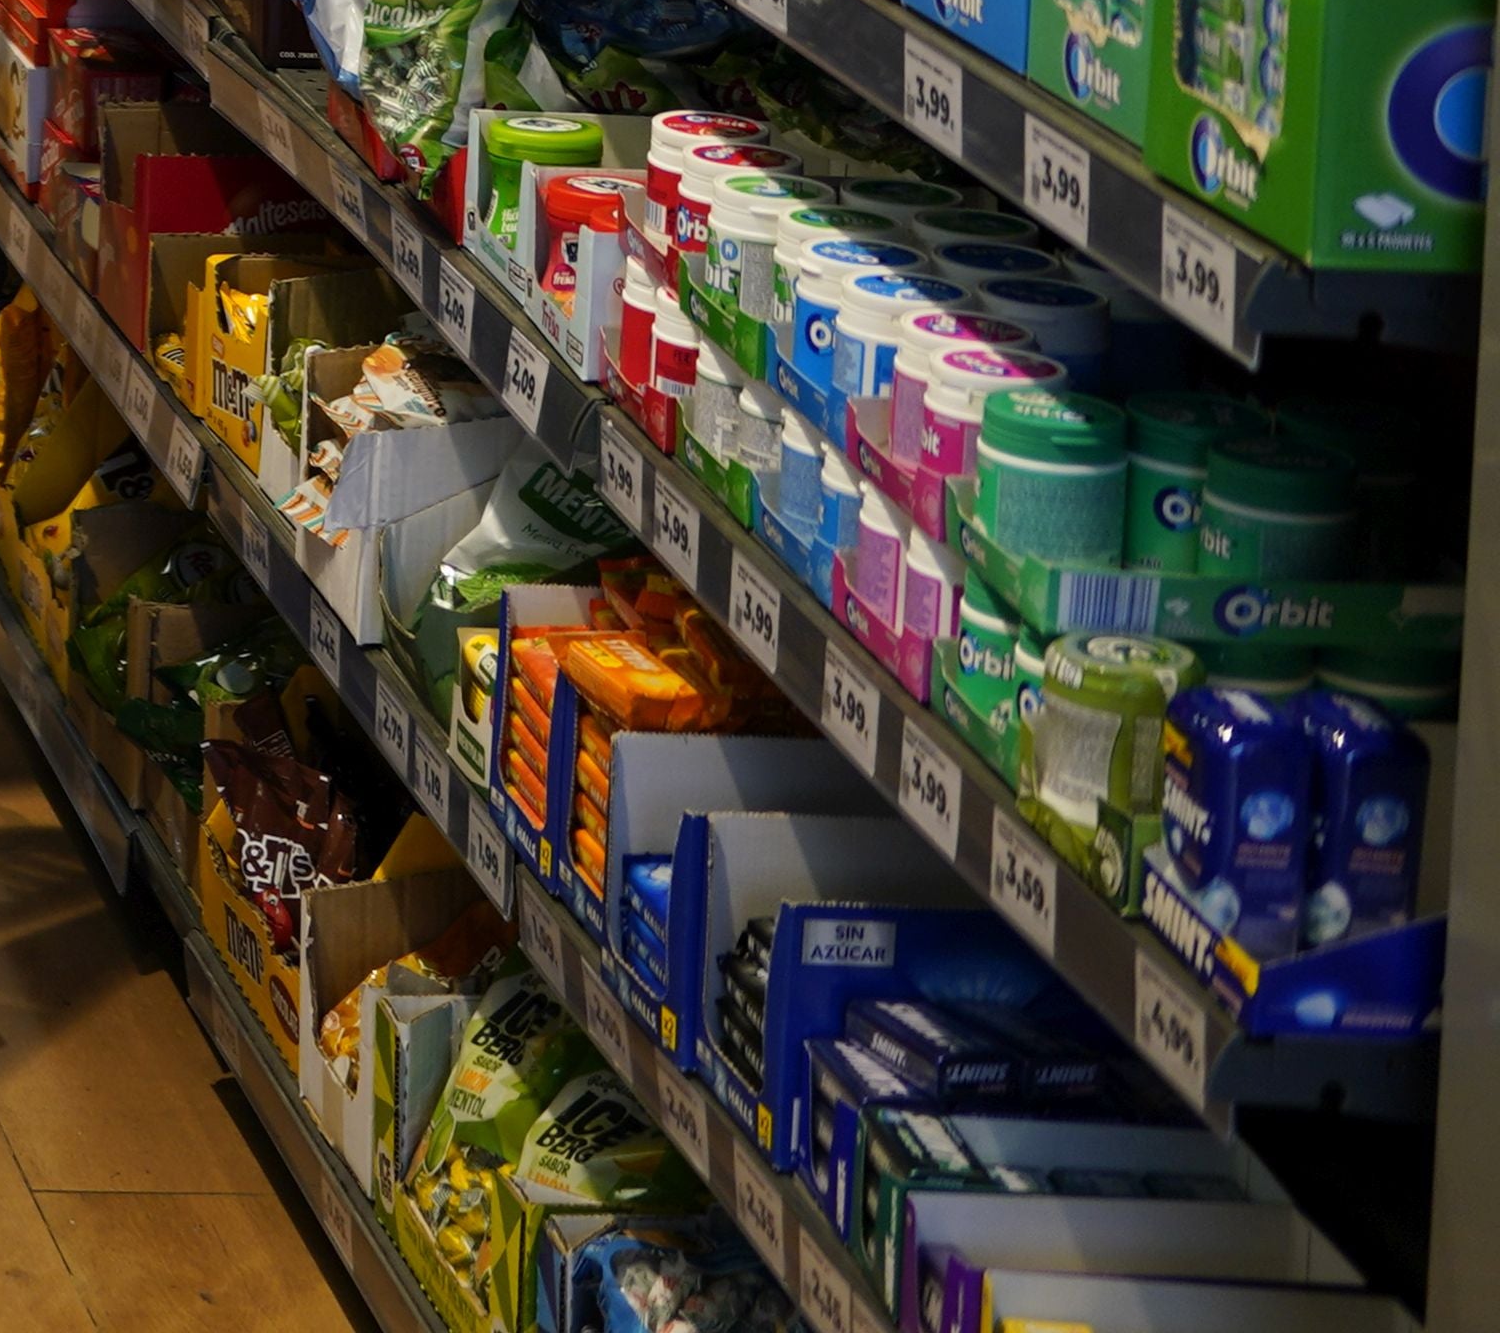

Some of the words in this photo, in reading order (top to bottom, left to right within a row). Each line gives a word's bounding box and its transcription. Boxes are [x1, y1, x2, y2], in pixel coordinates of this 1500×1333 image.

[1062, 31, 1122, 106] Orbit
[1214, 585, 1335, 638] Orbit
[835, 925, 865, 941] SIN
[810, 939, 888, 963] AZÚCAR
[535, 1123, 602, 1166] BERG
[538, 1153, 572, 1178] SABOR
